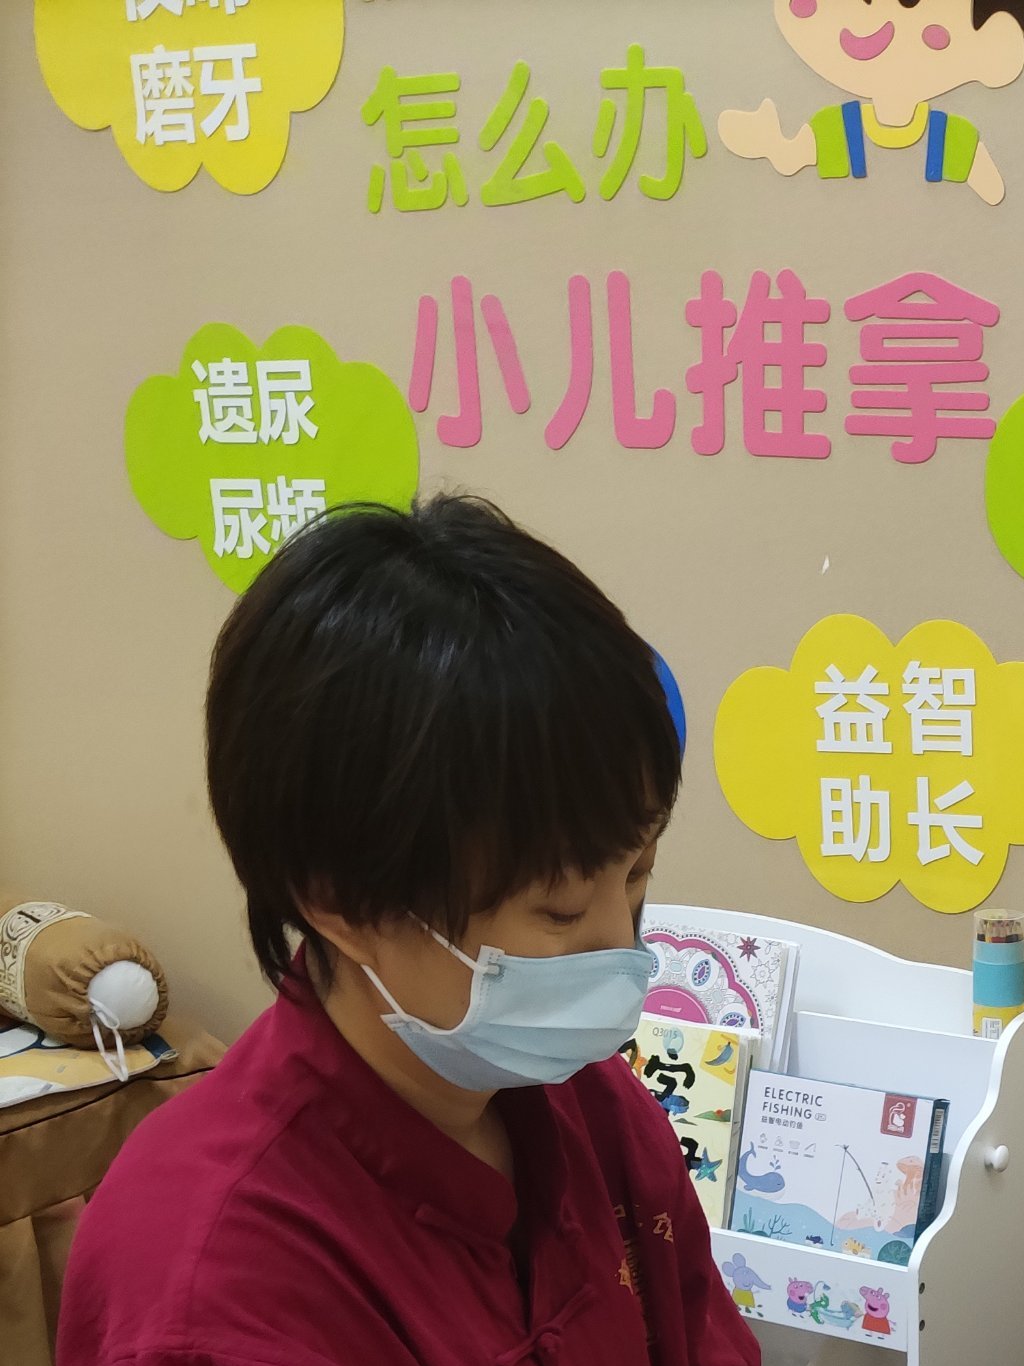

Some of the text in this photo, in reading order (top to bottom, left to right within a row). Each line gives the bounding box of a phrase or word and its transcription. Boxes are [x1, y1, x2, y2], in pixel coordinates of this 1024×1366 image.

[130, 43, 262, 146] 磨牙
[361, 42, 708, 214] 怎么办
[191, 357, 319, 445] 遗尿
[408, 268, 1001, 464] 小儿推拿
[814, 660, 976, 756] 益智
[820, 774, 985, 866] 助长
[762, 1101, 812, 1120] FISHING
[764, 1086, 824, 1107] ELECTRIC
